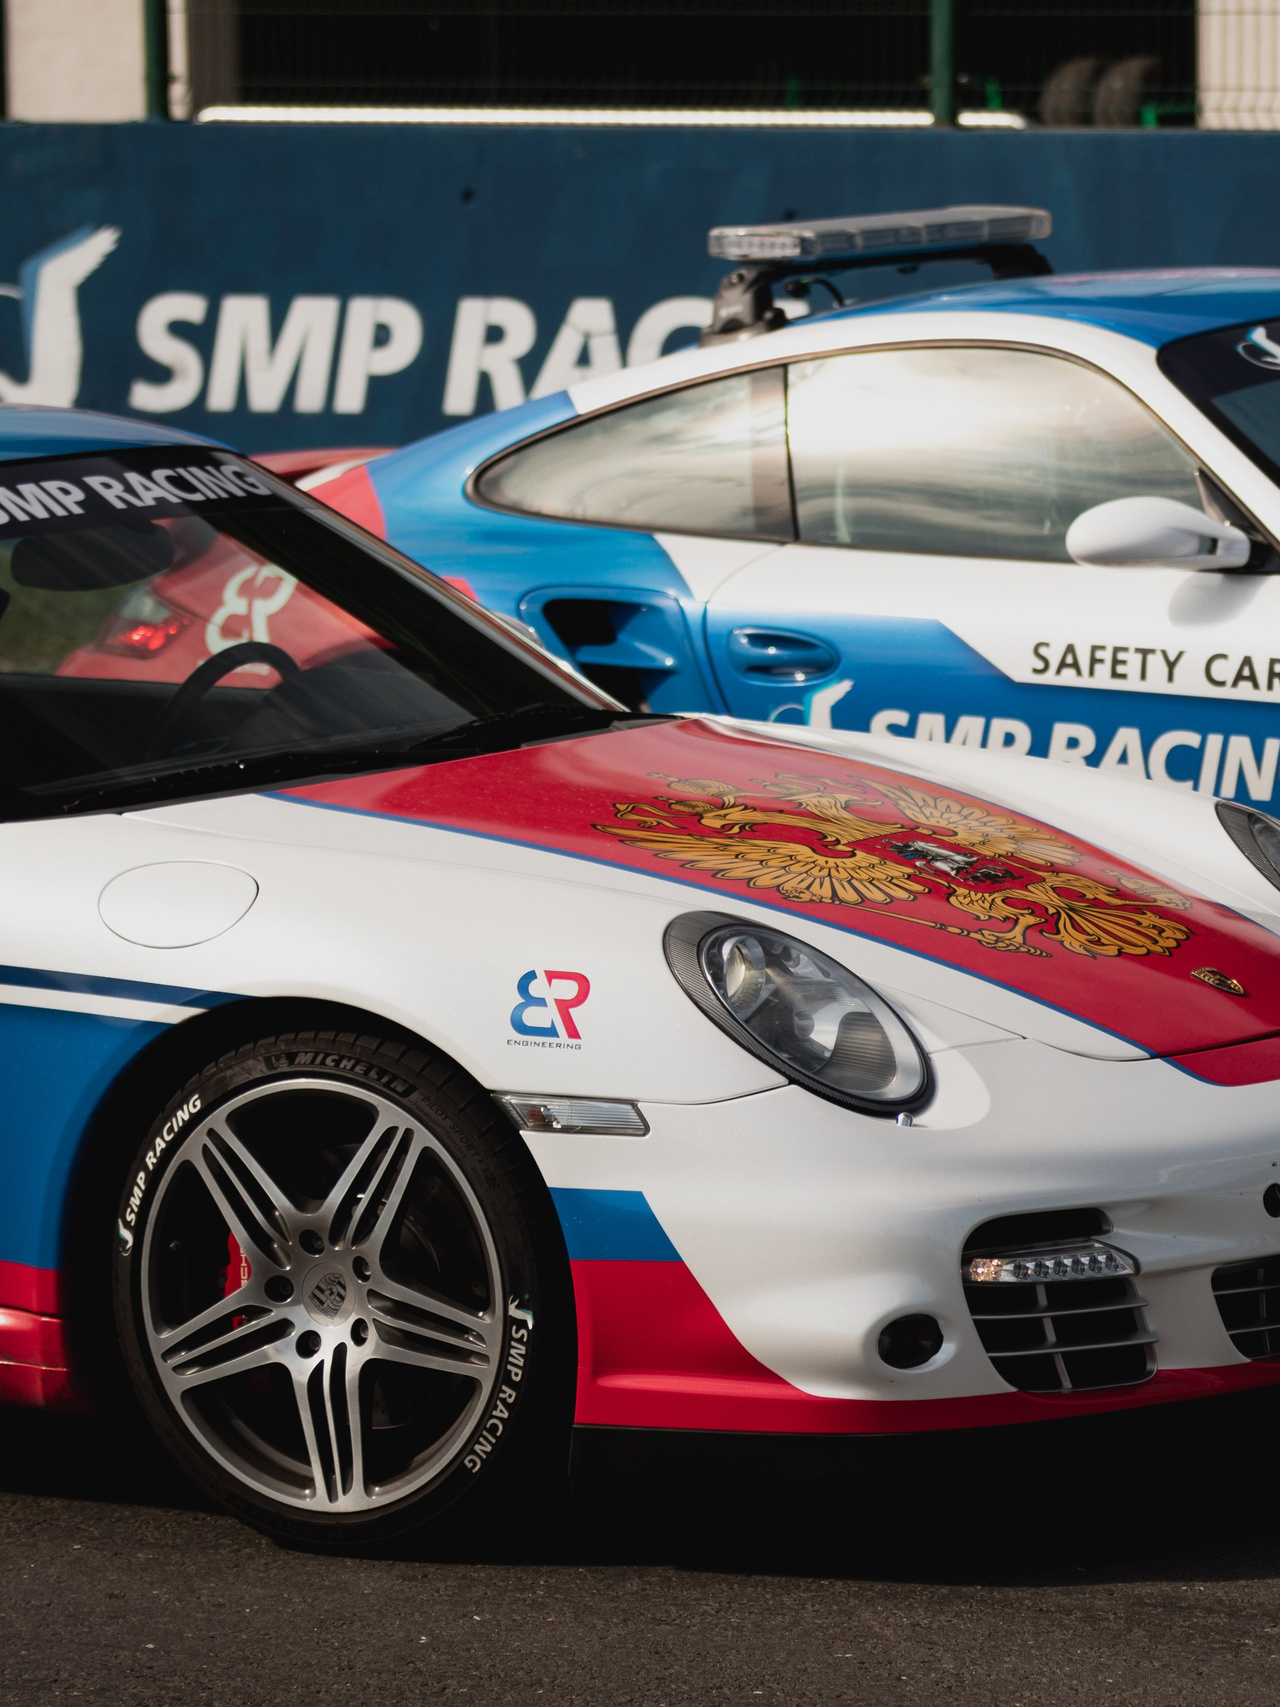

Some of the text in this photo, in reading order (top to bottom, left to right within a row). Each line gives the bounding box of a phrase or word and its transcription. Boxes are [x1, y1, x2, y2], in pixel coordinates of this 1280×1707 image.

[129, 292, 423, 414] SMP
[0, 464, 273, 526] MP RACING
[1031, 641, 1187, 684] SAFETY
[294, 1051, 413, 1094] MICHELIN
[506, 1039, 583, 1051] ENGINEERING
[125, 1093, 202, 1227] SMP RACING
[421, 1095, 451, 1123] PILOT
[449, 1122, 481, 1161] SPORT
[463, 1324, 529, 1474] SMP RACING
